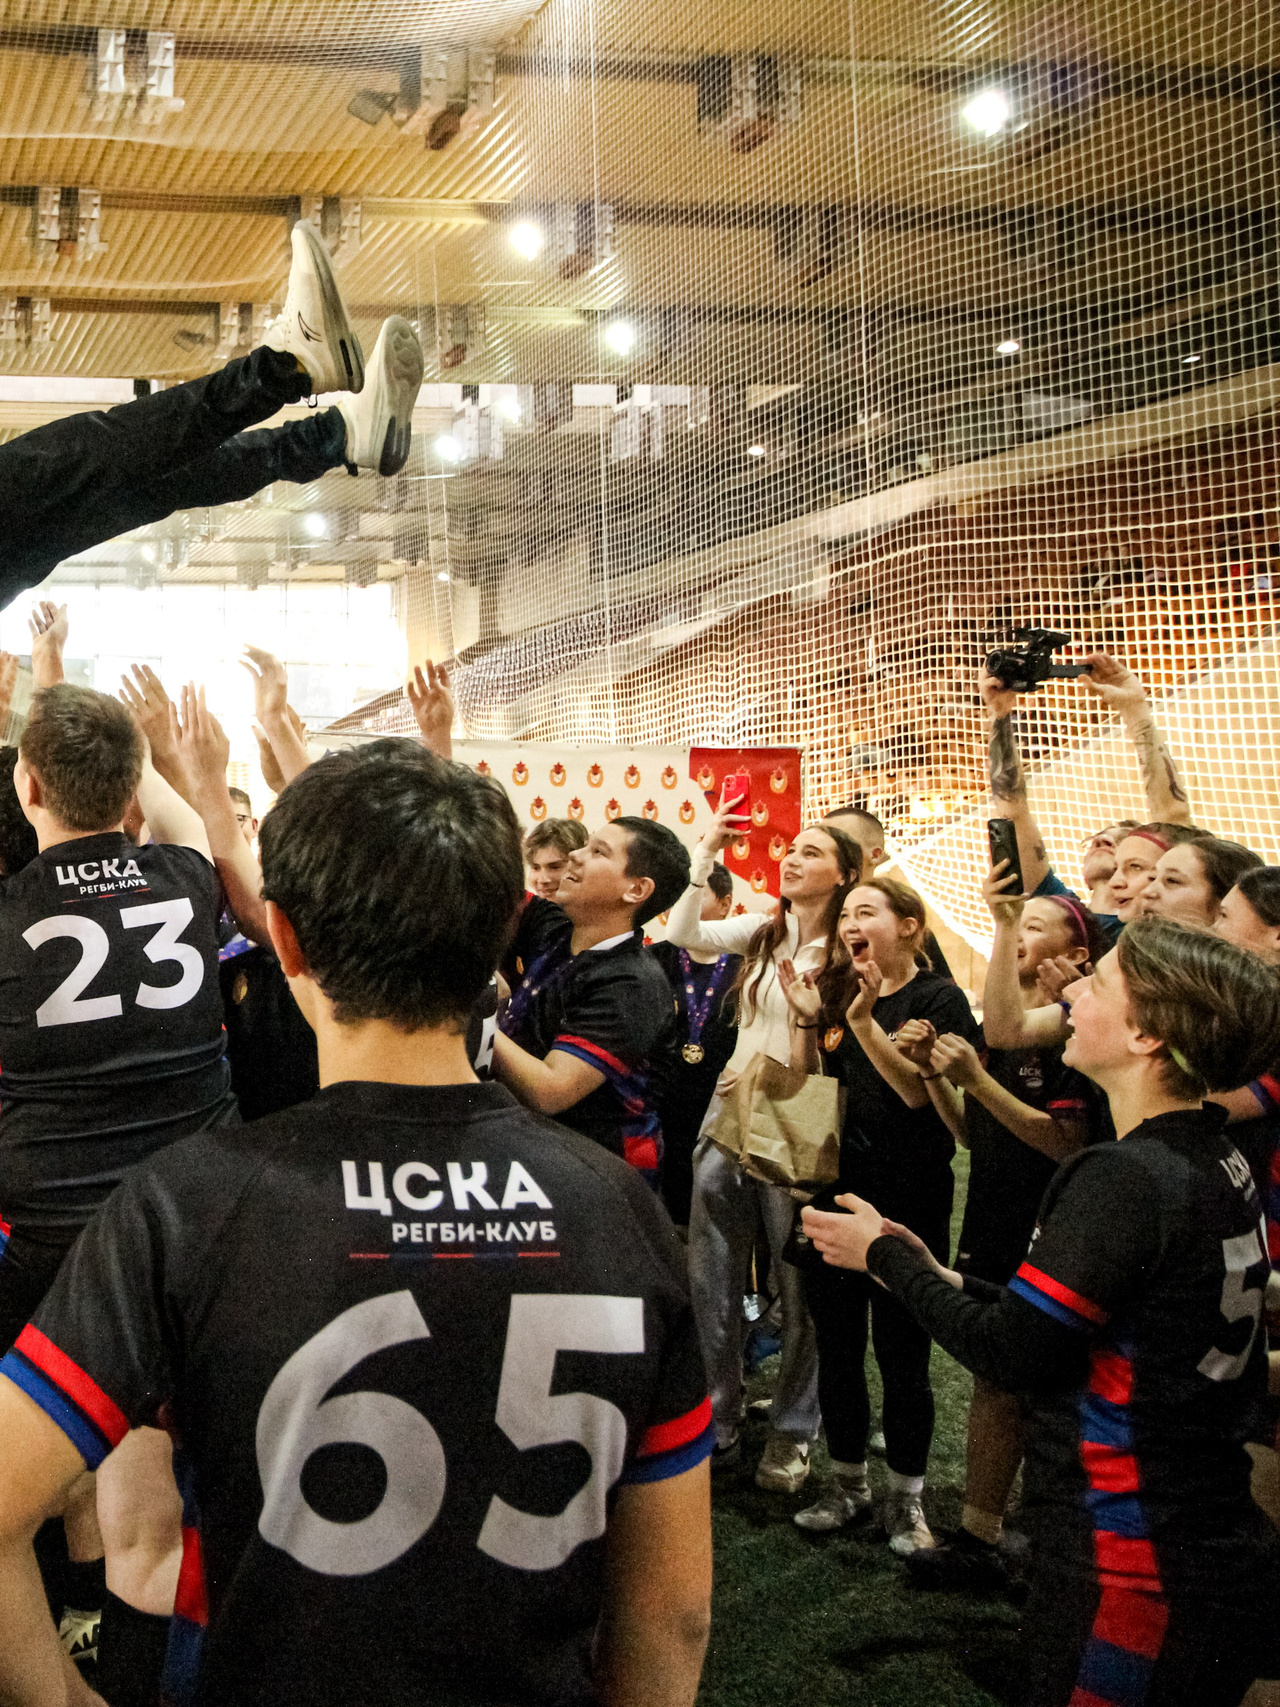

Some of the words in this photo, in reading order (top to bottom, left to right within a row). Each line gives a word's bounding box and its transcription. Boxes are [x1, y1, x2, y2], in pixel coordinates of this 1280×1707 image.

[55, 858, 142, 886] ЦСКА
[79, 878, 148, 895] РЕГБИ-КЛУБ
[21, 897, 205, 1028] 23
[341, 1160, 554, 1217] ЦСКА
[392, 1221, 558, 1243] РЕГБИ-КЛУБ
[255, 1289, 646, 1577] 65
